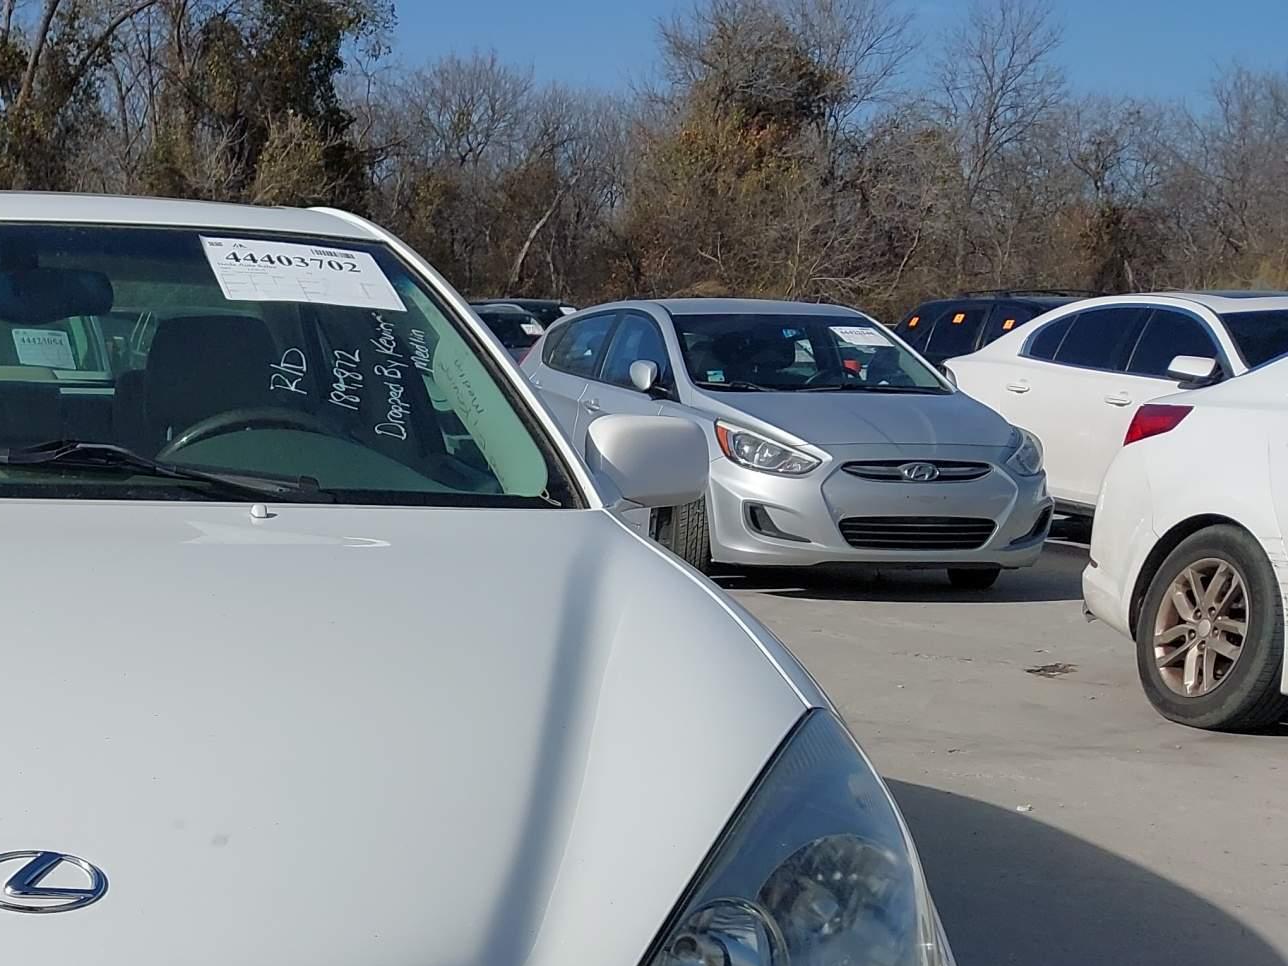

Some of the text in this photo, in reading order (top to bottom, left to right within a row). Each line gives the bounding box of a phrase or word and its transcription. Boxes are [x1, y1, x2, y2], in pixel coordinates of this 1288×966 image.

[225, 252, 362, 273] 44403702
[370, 319, 411, 441] Dropped By Kevin
